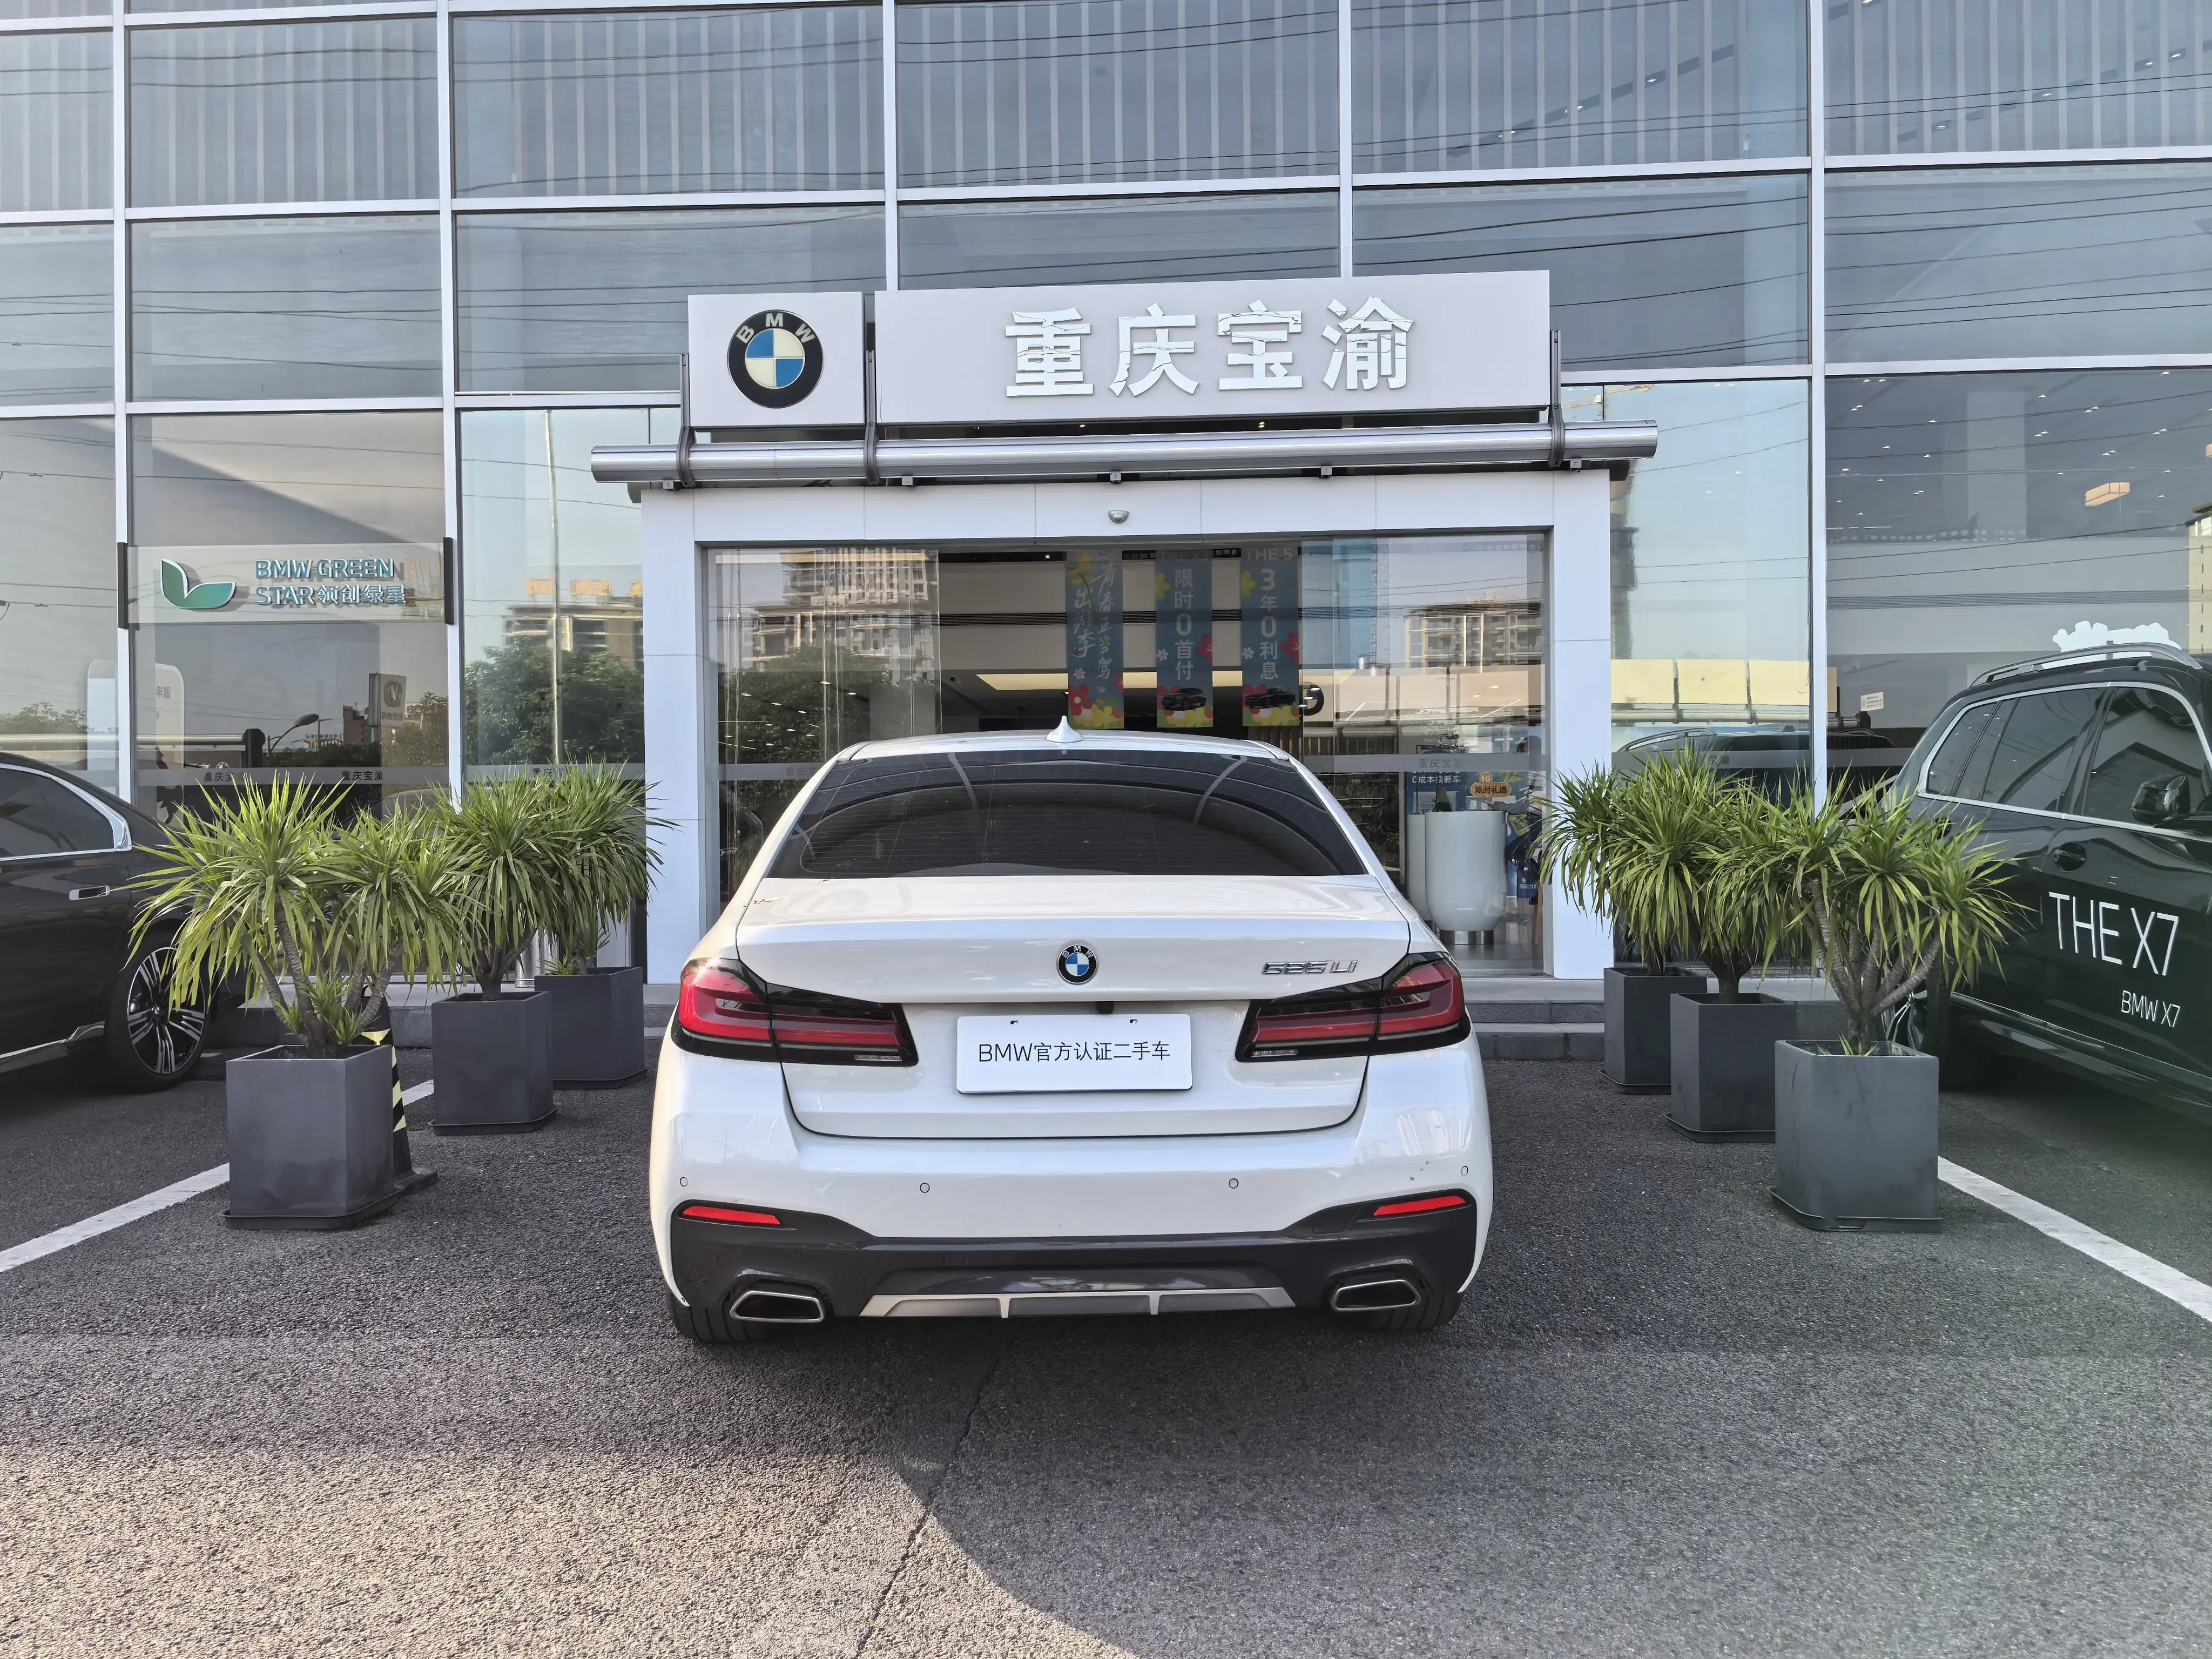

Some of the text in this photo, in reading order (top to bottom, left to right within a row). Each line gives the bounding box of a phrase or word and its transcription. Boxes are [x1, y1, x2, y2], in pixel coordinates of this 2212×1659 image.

[736, 313, 815, 343] BMW
[1006, 296, 1414, 397] 重庆宝渝
[1246, 548, 1278, 561] THE
[255, 558, 394, 579] BMW GREEN
[2048, 892, 2179, 976] THE X7
[1061, 946, 1094, 959] BMW
[2121, 990, 2181, 1027] BMW X7
[979, 1041, 1170, 1062] BMW官方认证二手车
